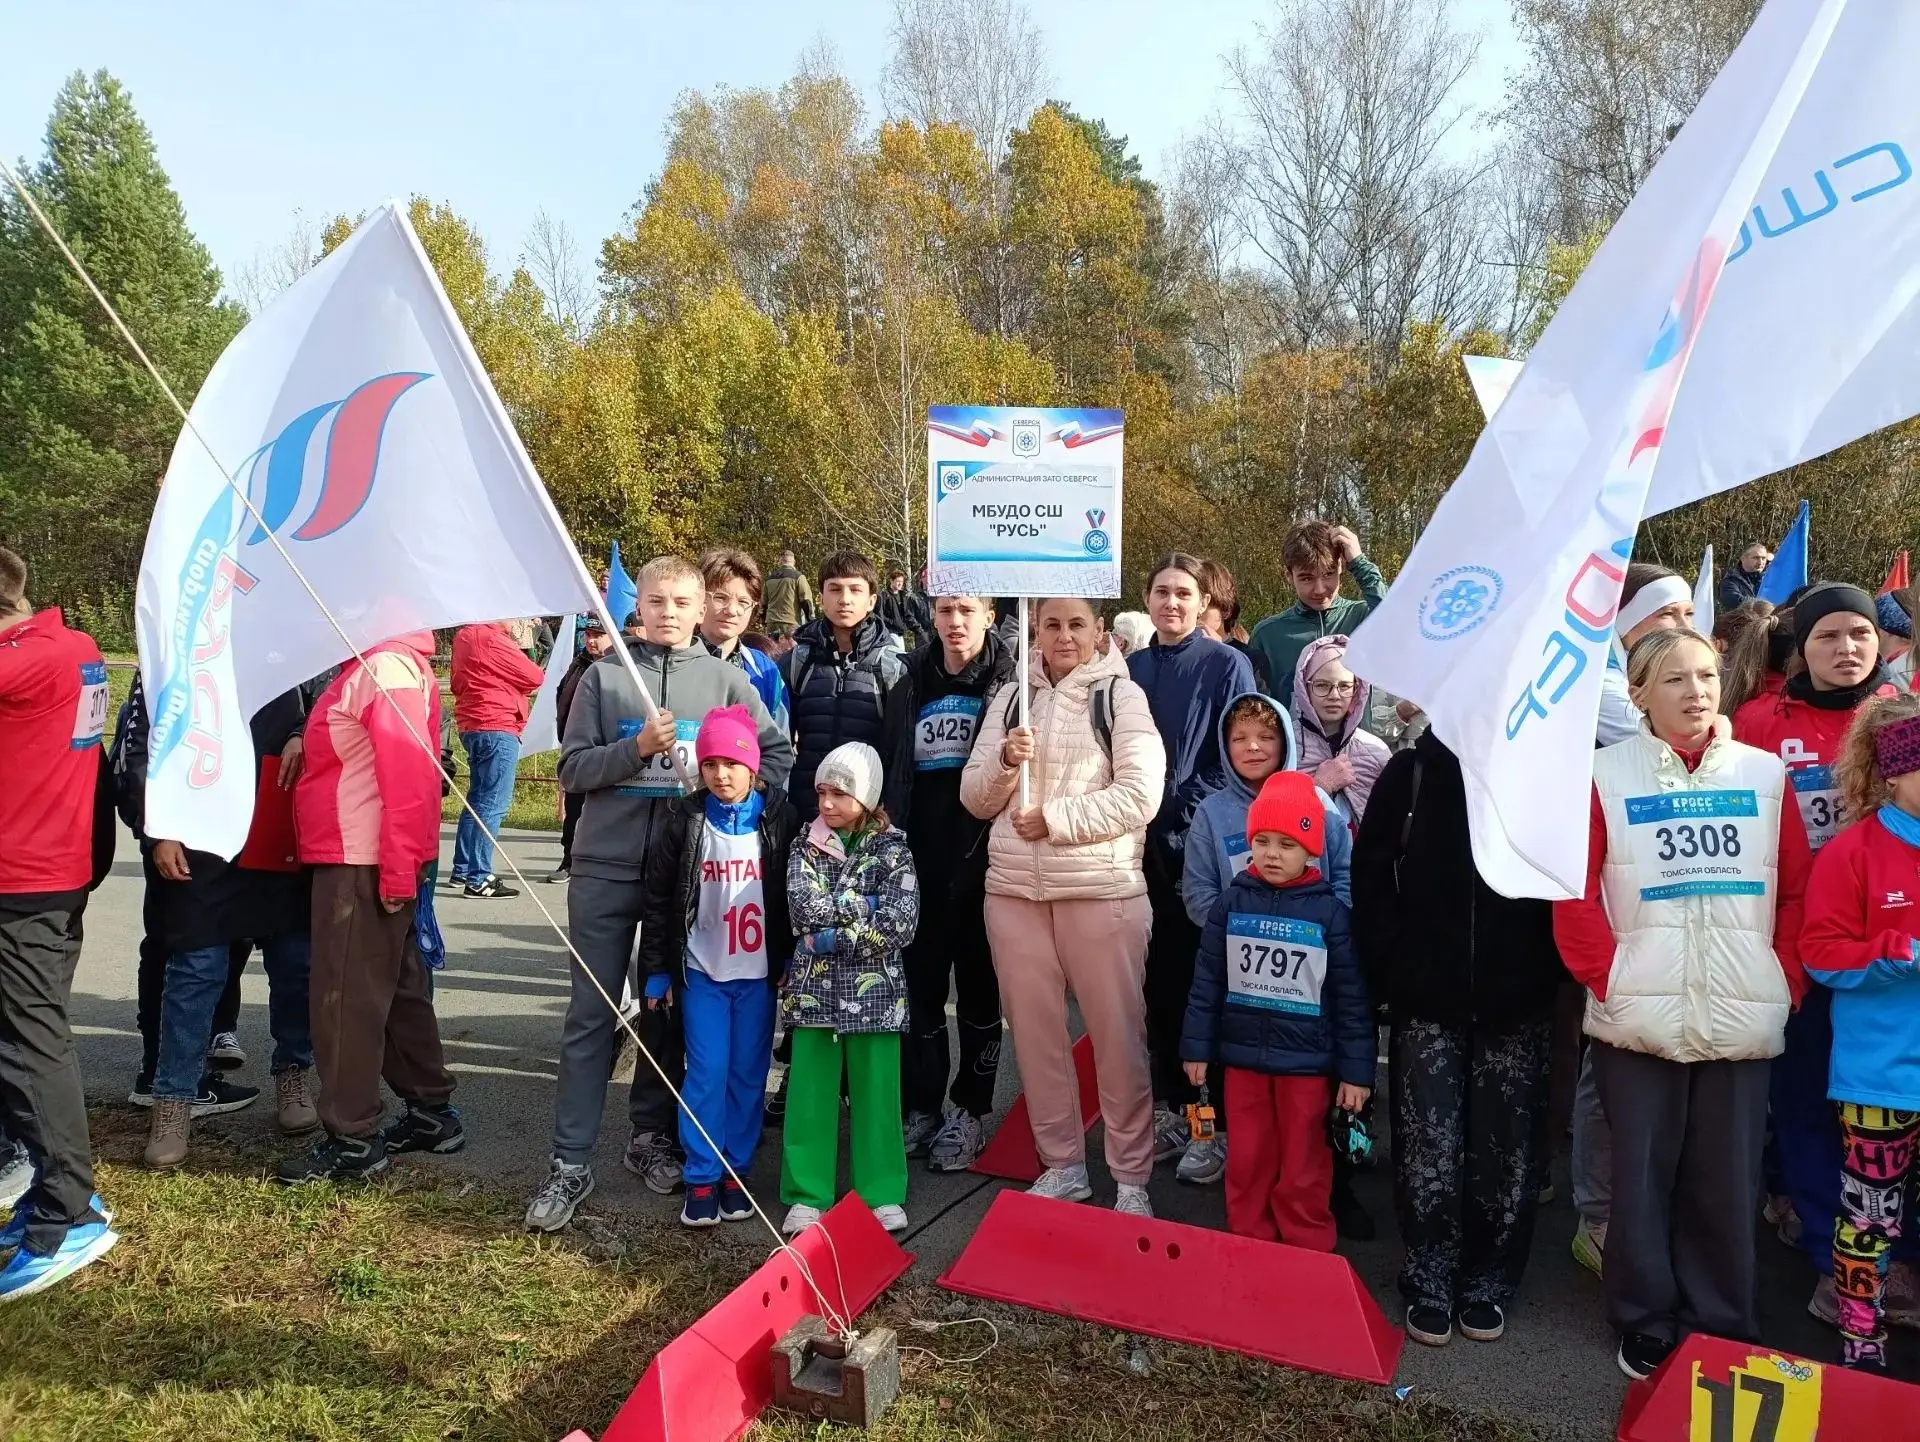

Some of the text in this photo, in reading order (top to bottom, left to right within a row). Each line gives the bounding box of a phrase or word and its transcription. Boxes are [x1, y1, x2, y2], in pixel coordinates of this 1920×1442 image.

[971, 475, 1041, 483] АДМИНИСТРАЦИЯ
[1063, 475, 1098, 483] СЕВЕРСК
[972, 505, 1063, 520] МБУДО СШ
[989, 524, 1047, 537] "РУСЬ"
[922, 718, 972, 744] 3425
[1672, 796, 1713, 808] КРОСС
[1655, 824, 1742, 861] 3308
[1661, 866, 1742, 878] ТОМСКАЯ ОБЛАСТЬ
[723, 903, 763, 955] 16
[1259, 920, 1293, 933] КРОСС
[1240, 943, 1308, 980] 3797
[1269, 985, 1304, 996] ОБЛАСТЬ
[1697, 1371, 1785, 1442] 17
